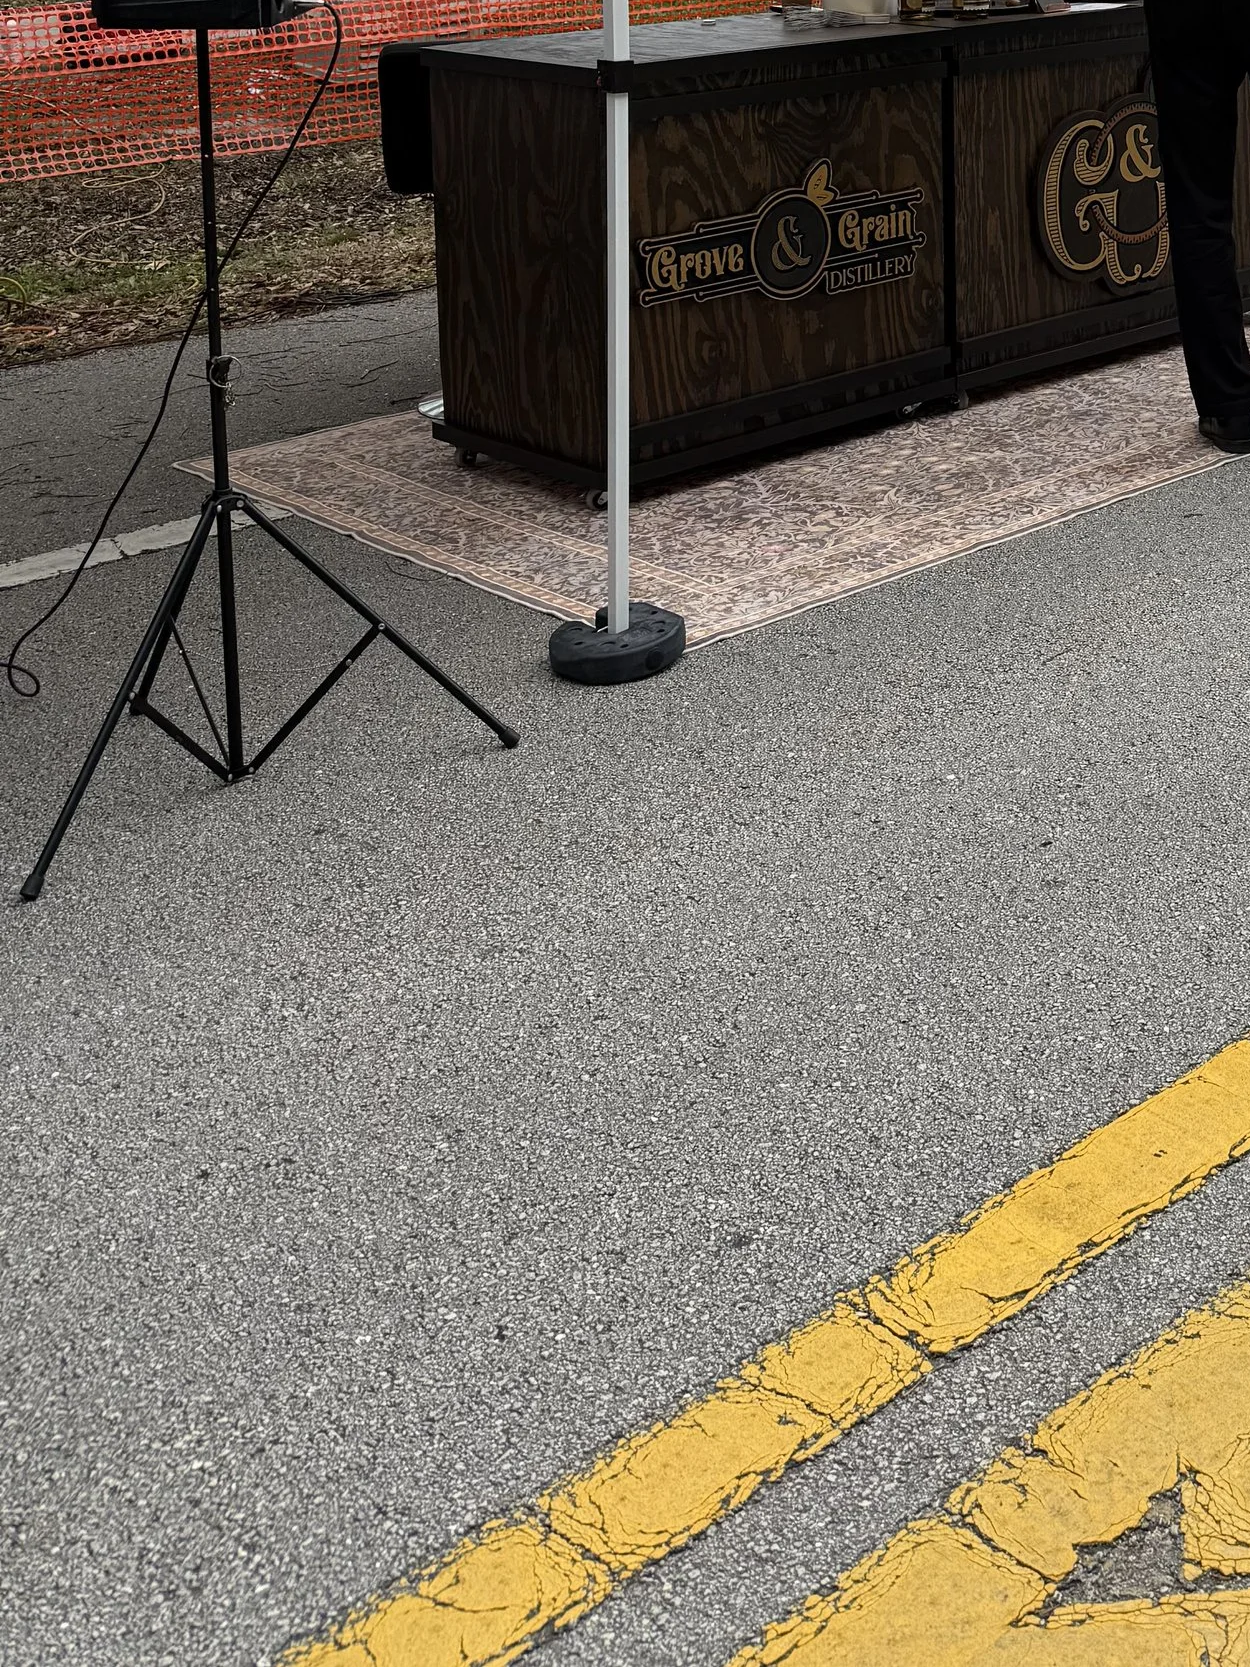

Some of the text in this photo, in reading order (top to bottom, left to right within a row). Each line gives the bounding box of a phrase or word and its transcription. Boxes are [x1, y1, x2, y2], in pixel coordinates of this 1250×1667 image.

[651, 205, 914, 290] Grove & Grain
[829, 252, 914, 290] DISTILLERY
